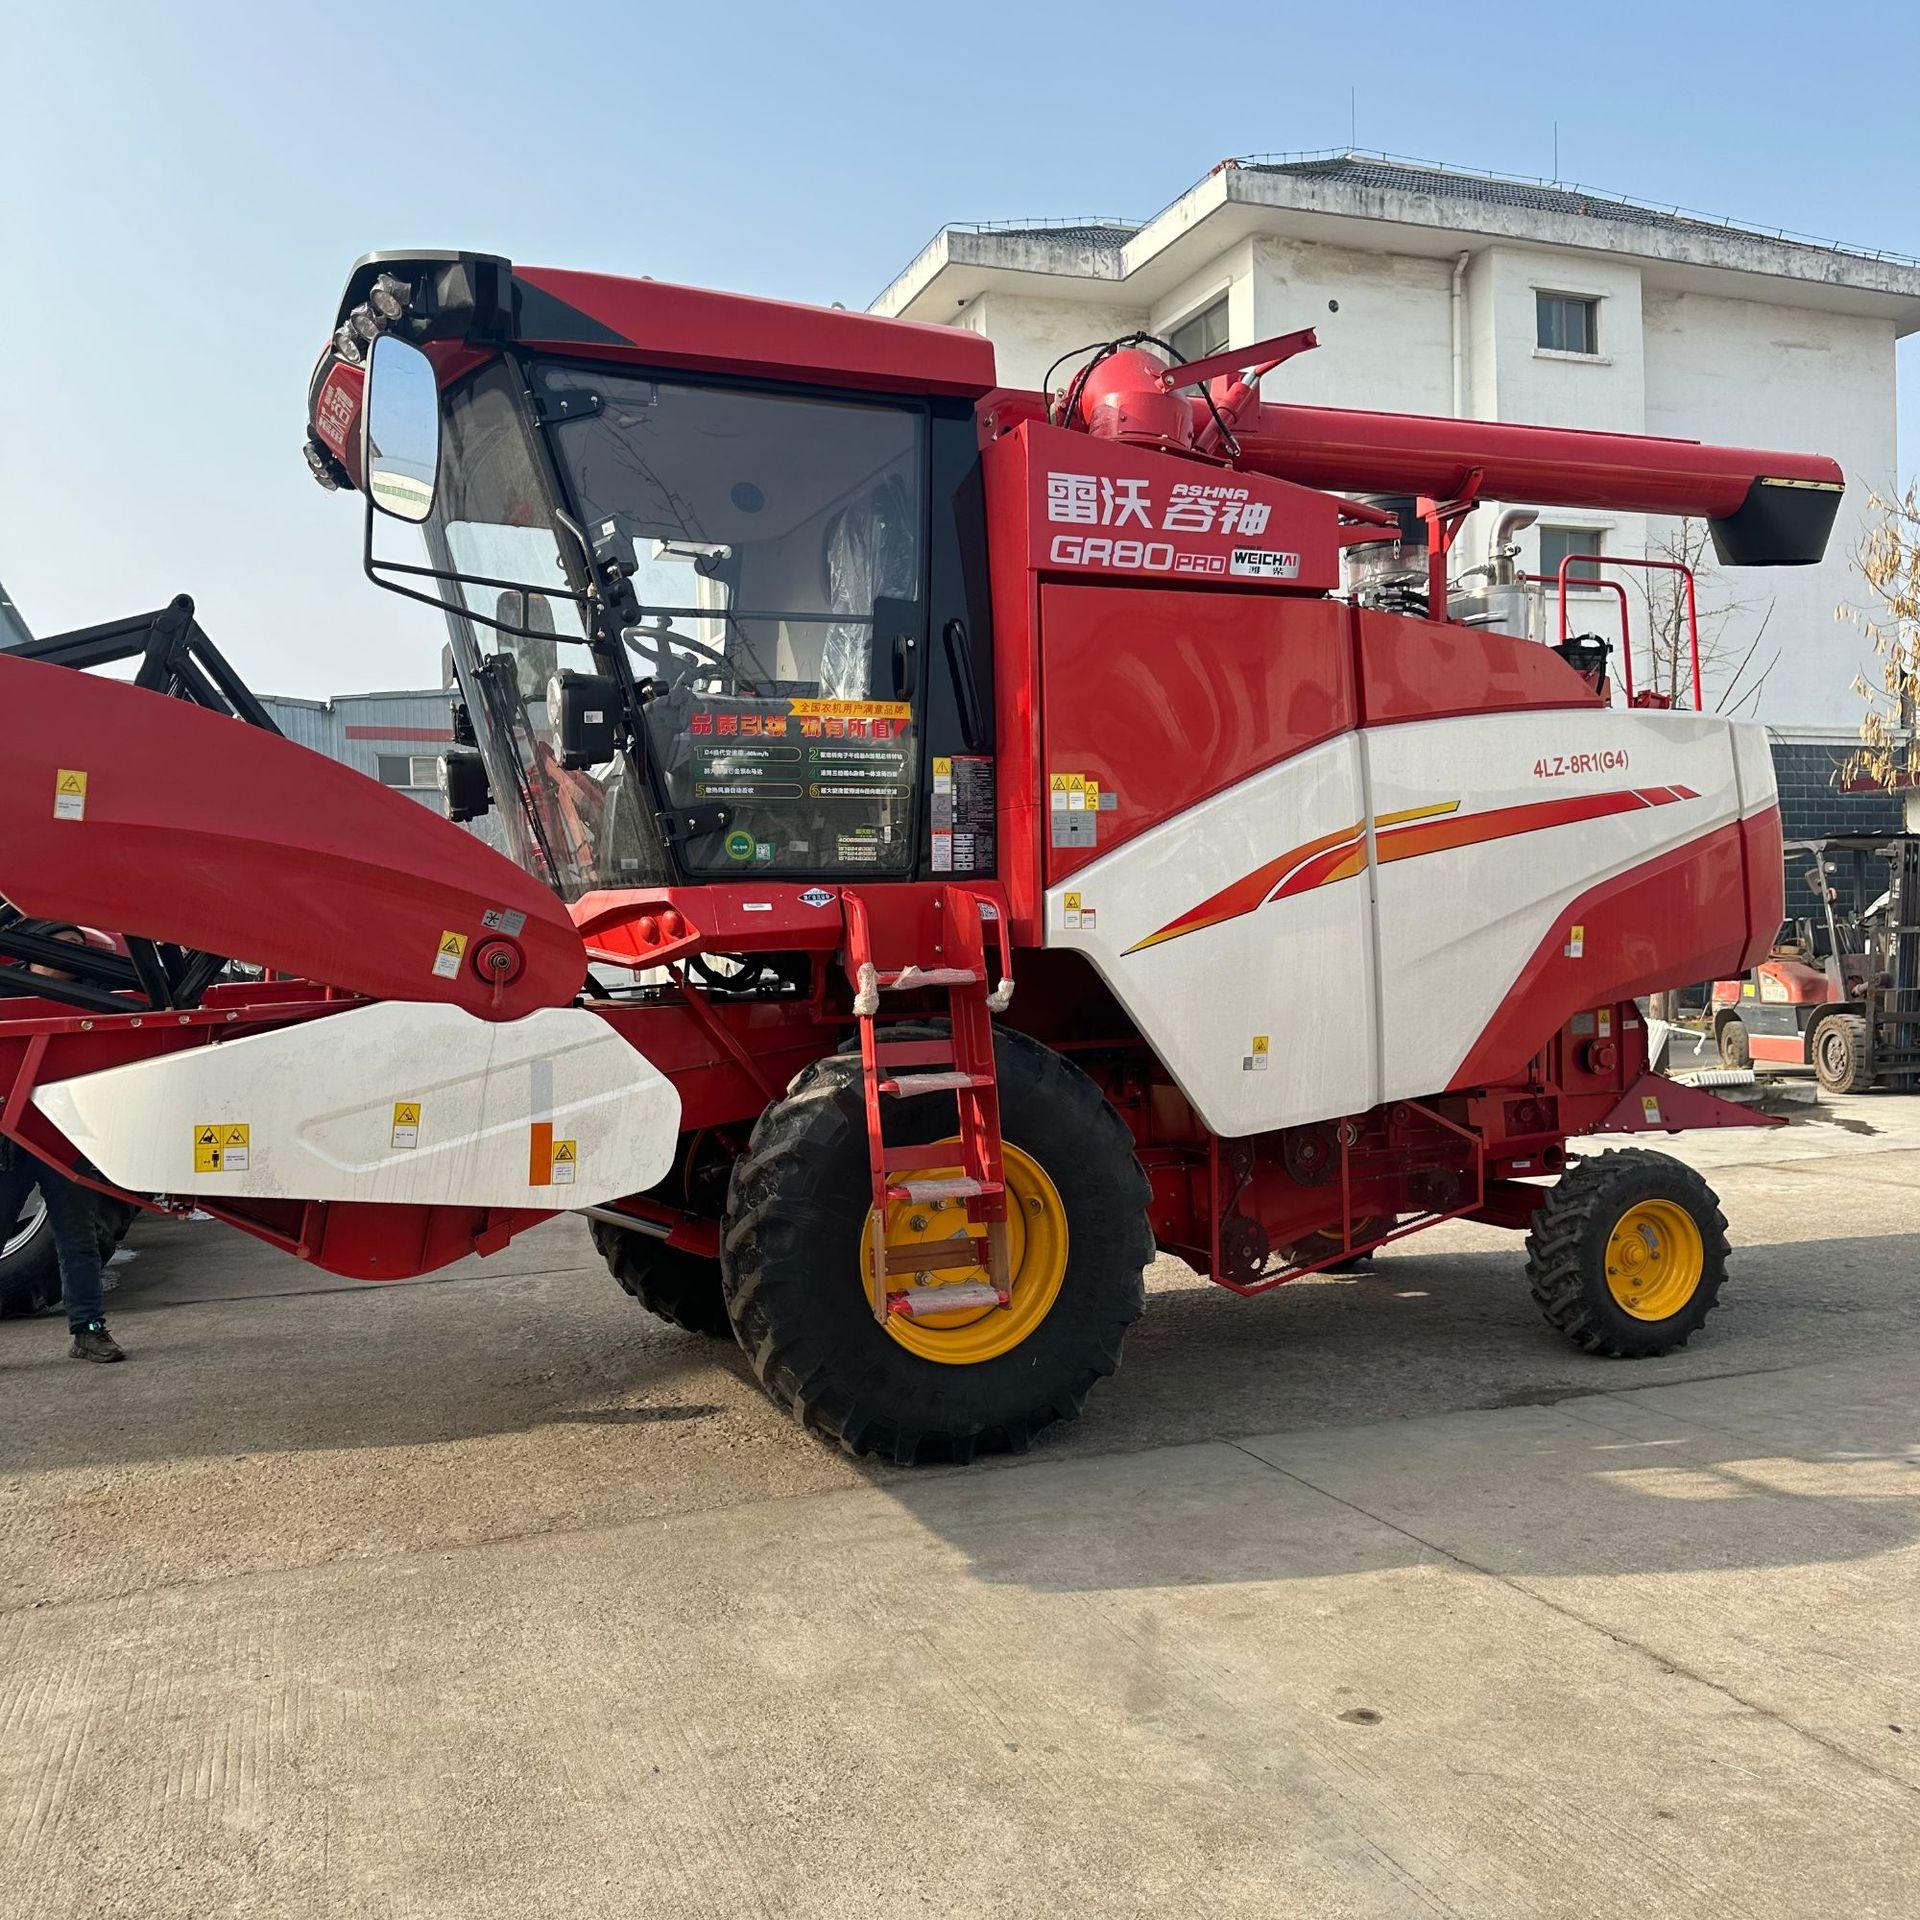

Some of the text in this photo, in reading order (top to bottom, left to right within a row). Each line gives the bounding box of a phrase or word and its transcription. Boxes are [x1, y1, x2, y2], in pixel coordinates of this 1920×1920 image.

[1172, 484, 1249, 500] ASHNA
[1050, 535, 1225, 573] GR80 PRO
[1234, 551, 1297, 567] WEICHAI
[799, 702, 905, 716] 全国农机用户满意品牌
[1533, 750, 1629, 778] 4LZ-8R1(G4)
